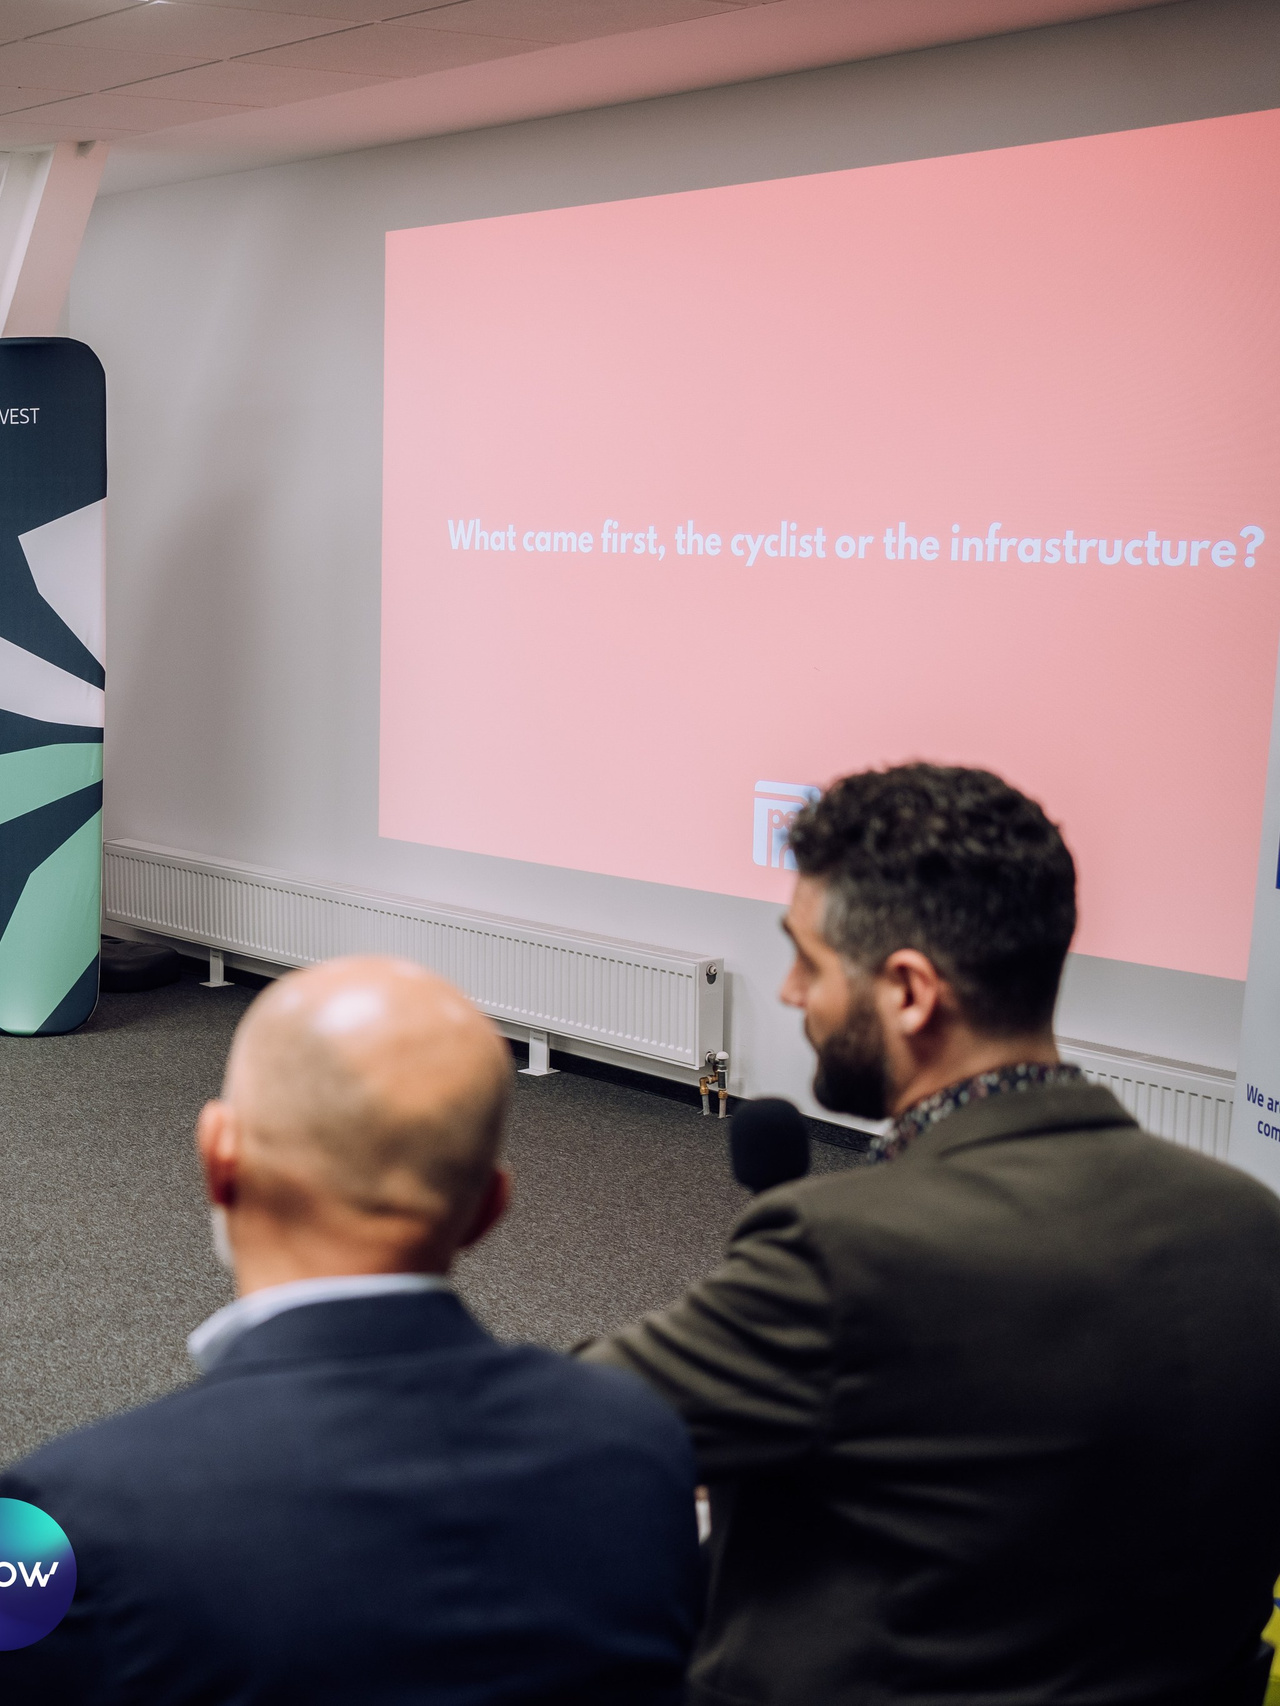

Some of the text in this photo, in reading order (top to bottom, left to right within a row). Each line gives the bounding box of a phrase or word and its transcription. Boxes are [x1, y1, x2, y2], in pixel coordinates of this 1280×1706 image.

[447, 518, 1265, 568] What came first, the cyclist or the infrastructure?
[1246, 1083, 1280, 1114] We ar
